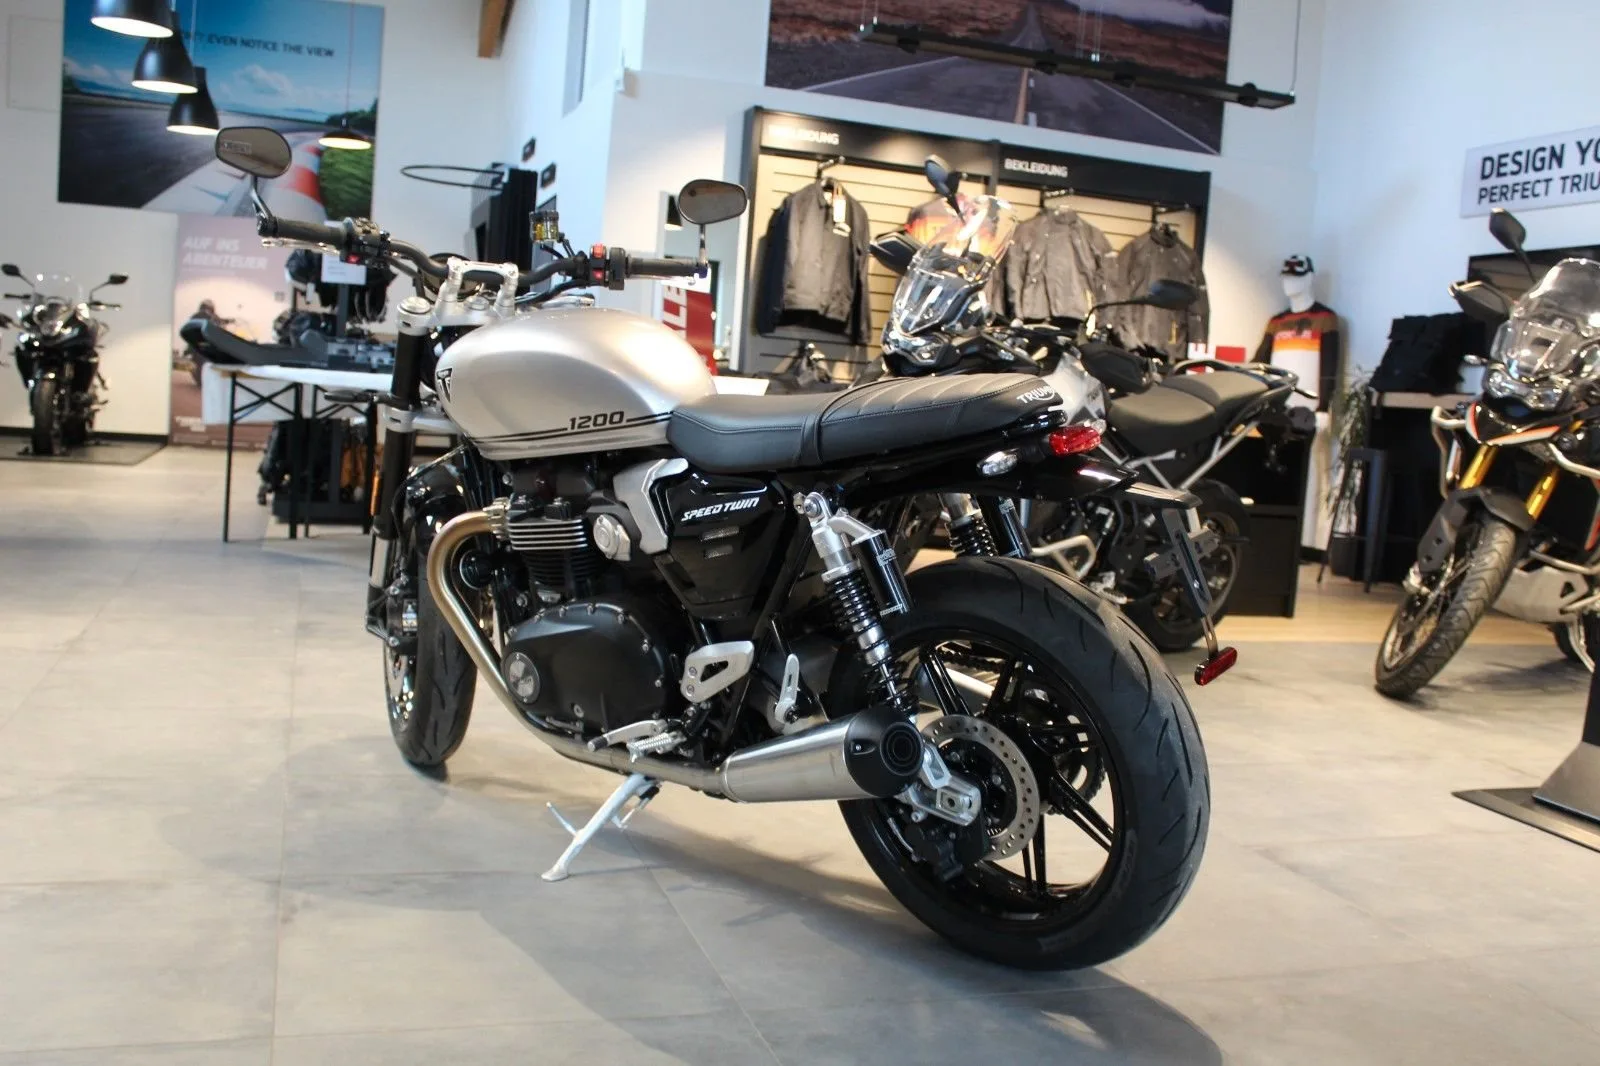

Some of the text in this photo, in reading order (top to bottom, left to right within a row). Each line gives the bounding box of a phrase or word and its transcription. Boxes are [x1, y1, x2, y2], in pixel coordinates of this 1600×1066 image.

[208, 33, 238, 46] EVEN
[239, 36, 279, 52] NOTICE
[282, 42, 303, 54] THE
[307, 45, 335, 57] VIEW
[1004, 157, 1068, 178] BEKLEIDUNG
[1480, 143, 1565, 180] DESIGN
[1477, 178, 1553, 205] PERFECT
[1016, 385, 1055, 404] TRIUM
[569, 411, 625, 430] 1200
